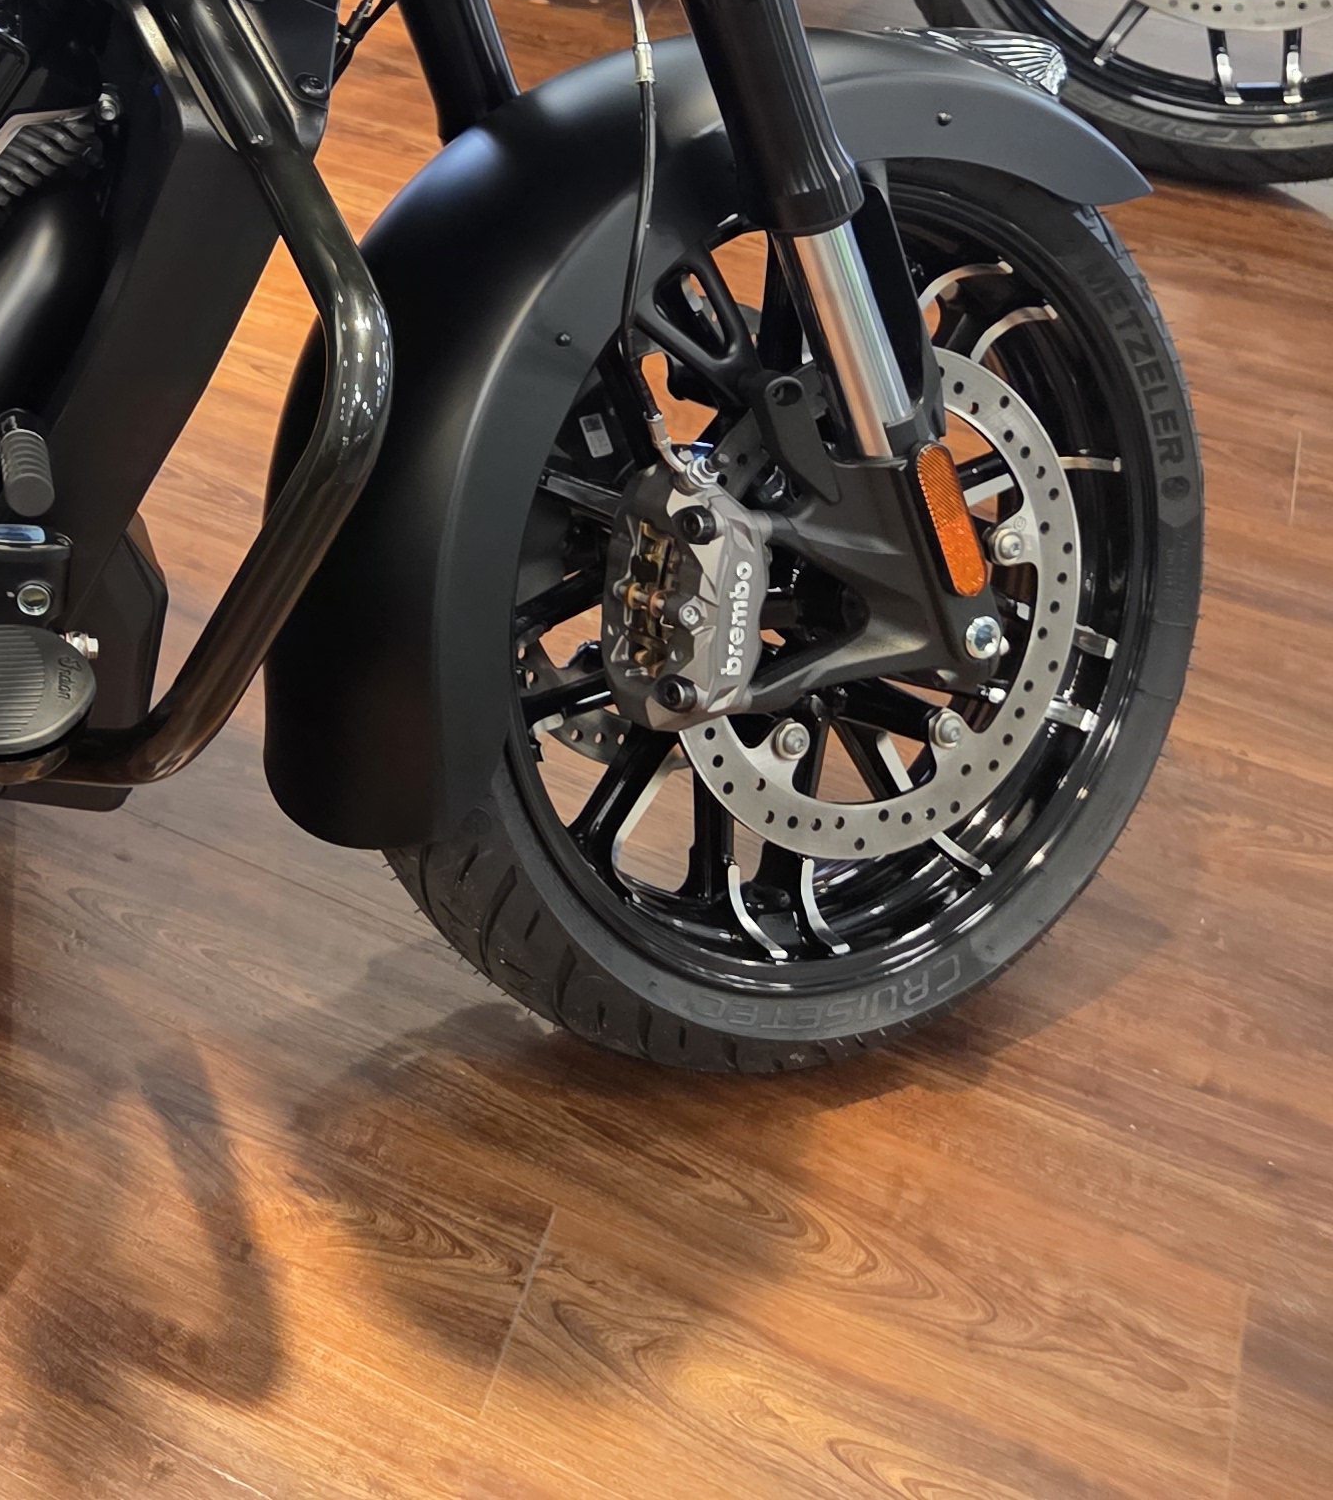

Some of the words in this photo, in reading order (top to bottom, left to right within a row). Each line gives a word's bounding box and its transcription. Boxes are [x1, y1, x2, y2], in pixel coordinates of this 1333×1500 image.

[1077, 259, 1186, 466] METZELER
[720, 560, 753, 676] brembo
[58, 656, 83, 700] Indian
[687, 953, 962, 1031] CRUISETEC
